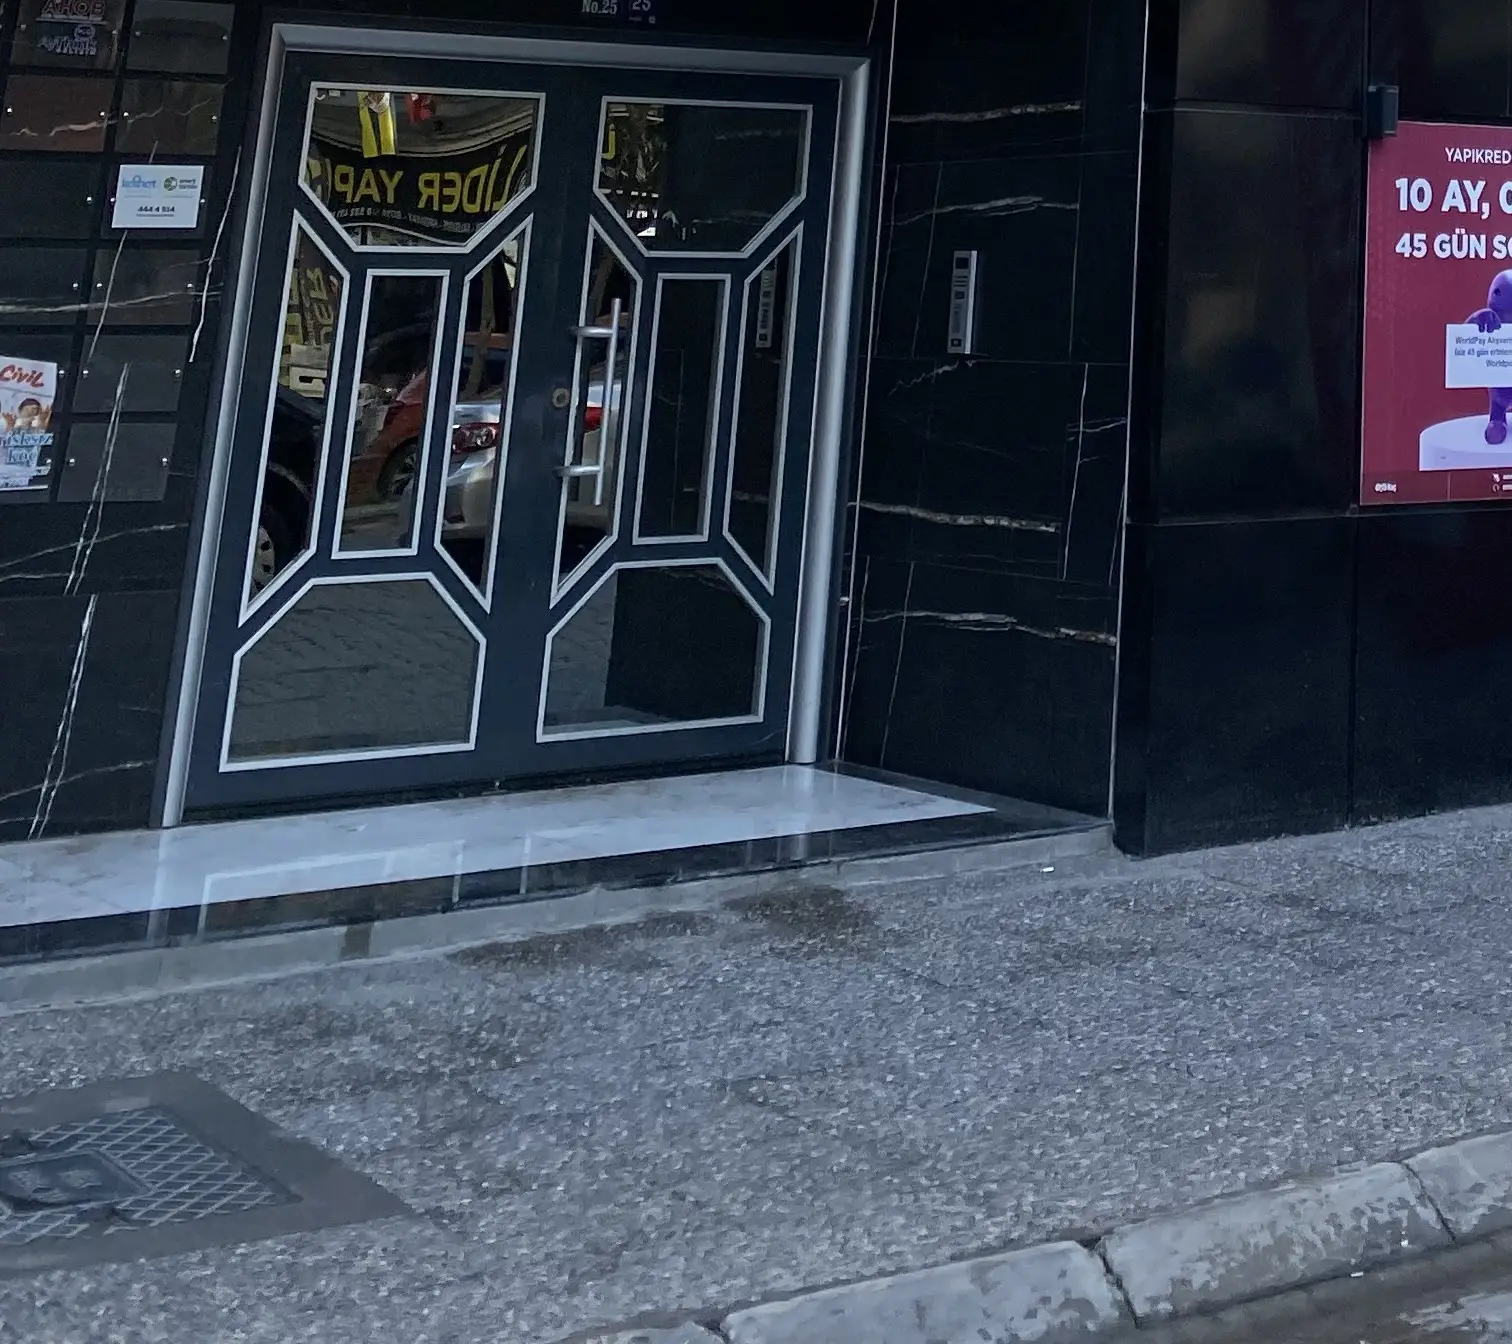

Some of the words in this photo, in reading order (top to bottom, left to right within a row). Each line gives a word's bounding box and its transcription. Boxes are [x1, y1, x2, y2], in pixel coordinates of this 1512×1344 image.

[1395, 178, 1433, 213] 10
[1441, 179, 1491, 220] AY,
[1395, 232, 1427, 259] 45
[1433, 229, 1486, 259] GÜN
